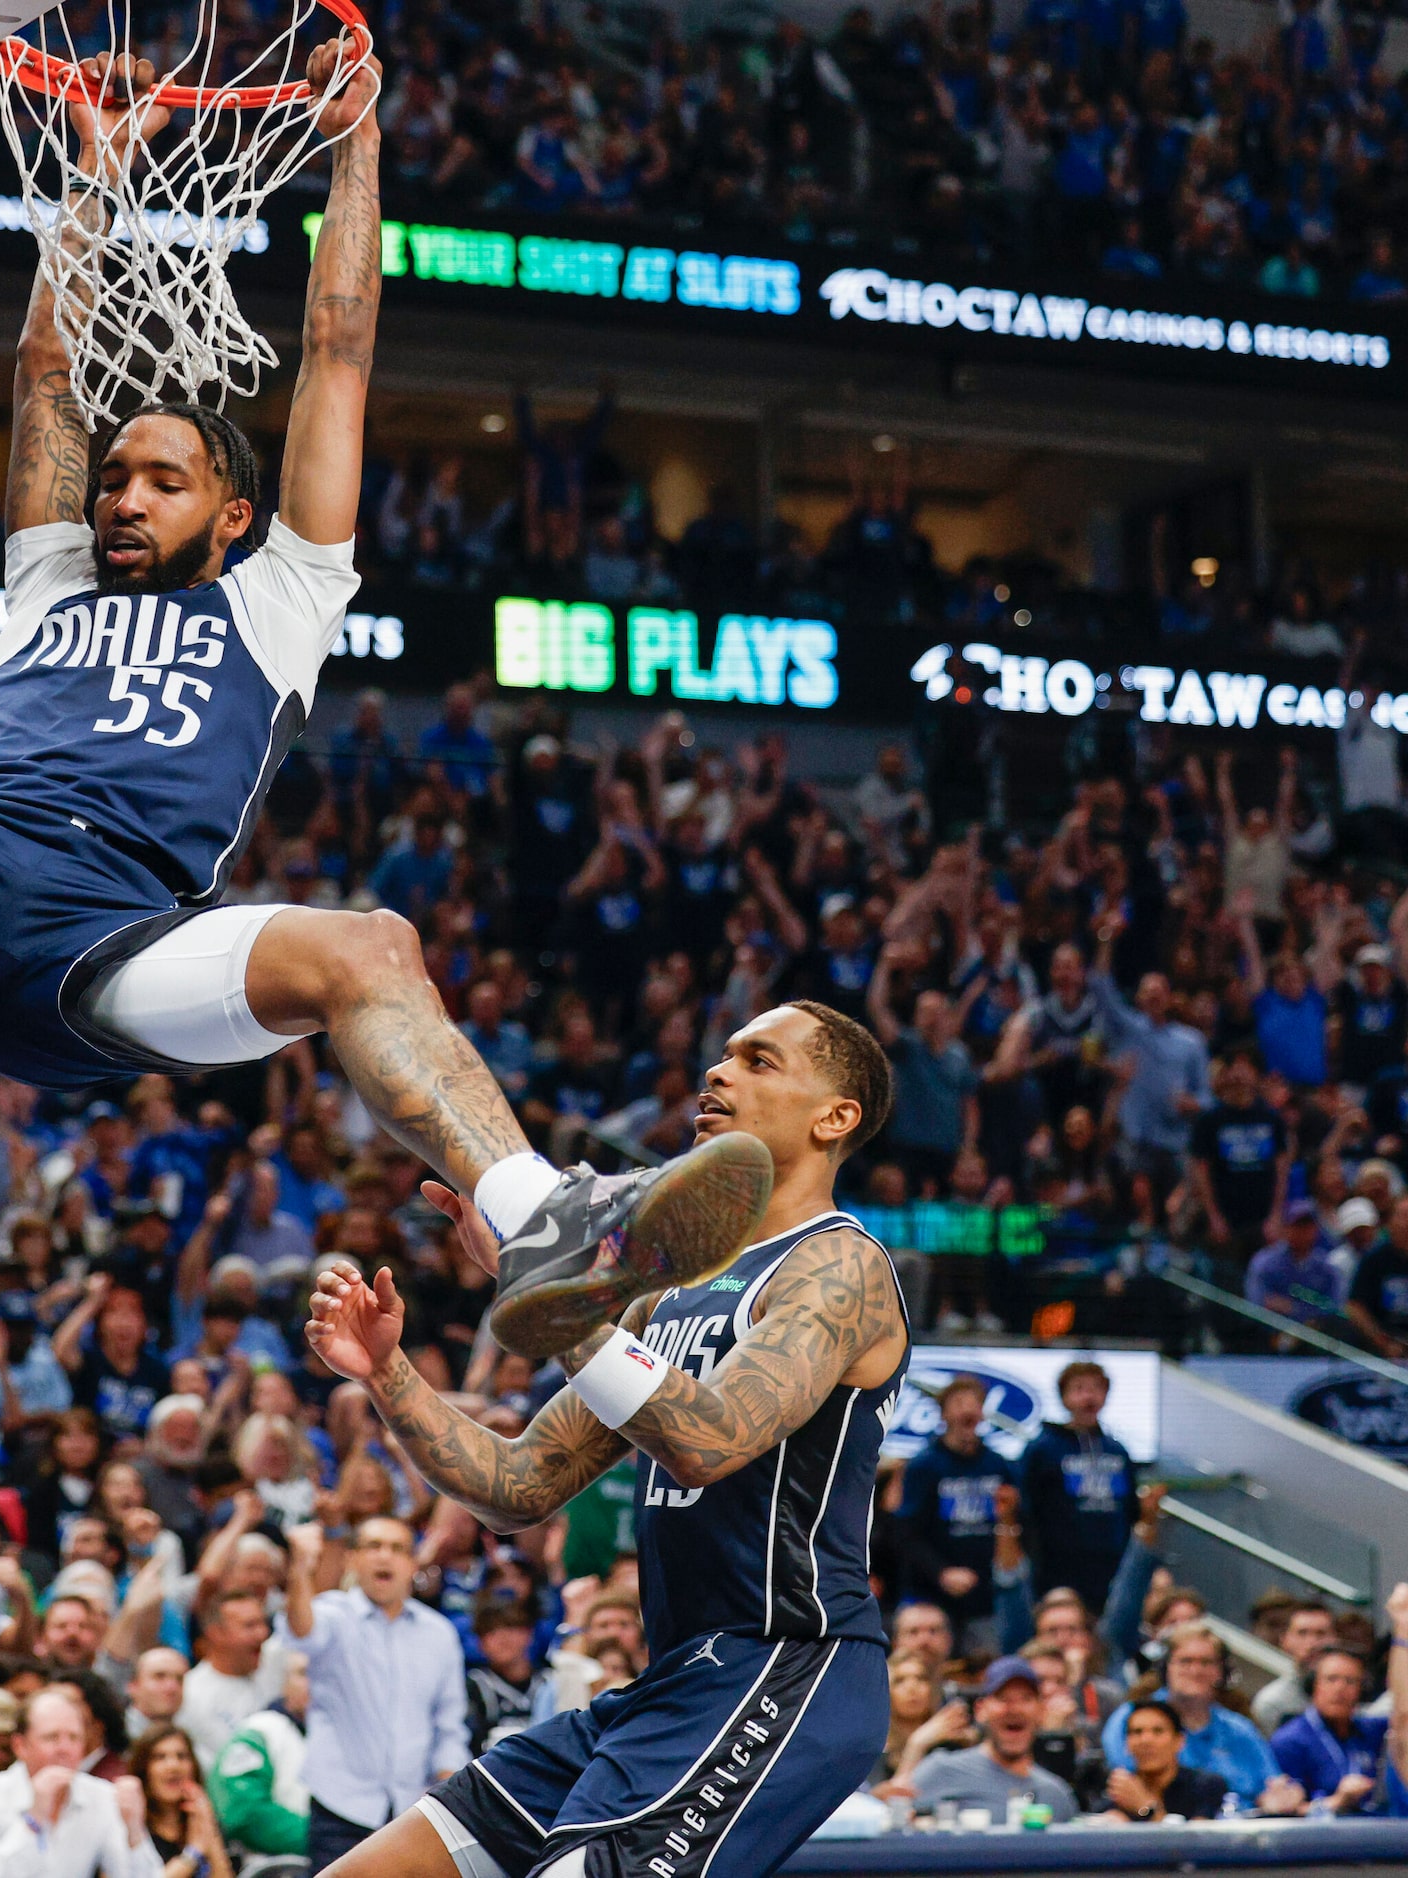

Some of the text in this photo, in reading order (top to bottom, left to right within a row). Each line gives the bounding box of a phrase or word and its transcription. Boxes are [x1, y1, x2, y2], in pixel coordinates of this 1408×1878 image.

[407, 223, 516, 288] YOUR
[518, 235, 624, 298] SHOT
[622, 246, 677, 303] AT
[676, 250, 801, 316] SLOTS
[848, 267, 1391, 369] CHOCTAW CASINOS & RESORTS
[495, 596, 839, 709] BIG PLAYS
[92, 666, 213, 748] 55
[708, 1274, 748, 1292] chime
